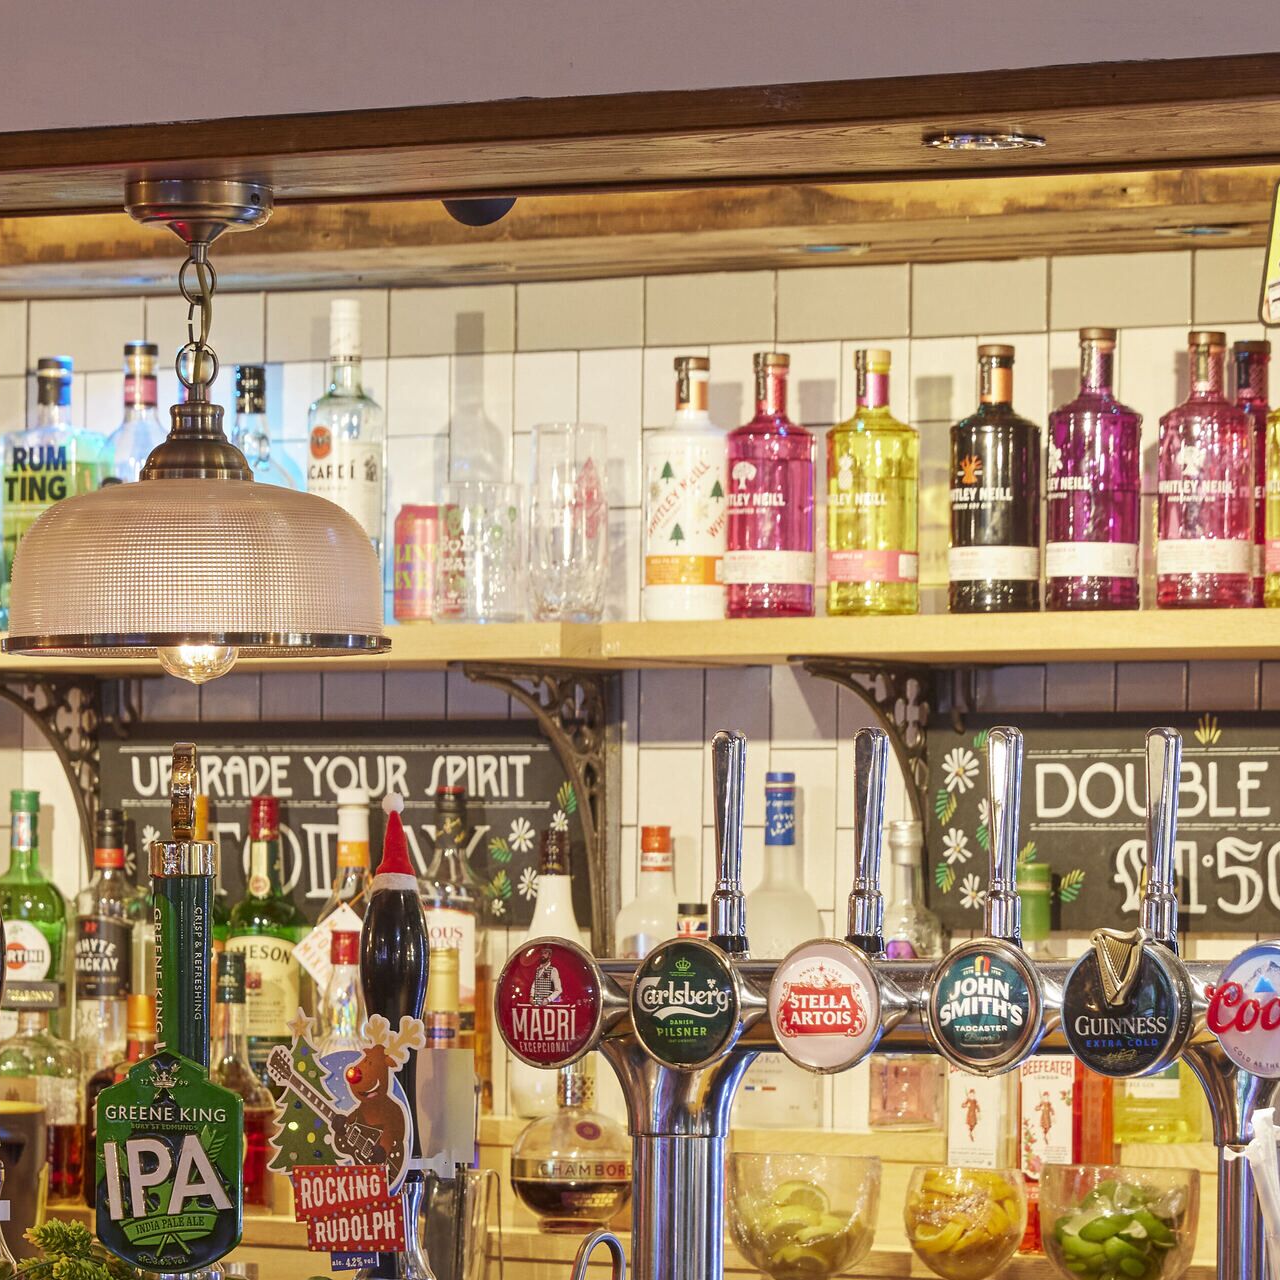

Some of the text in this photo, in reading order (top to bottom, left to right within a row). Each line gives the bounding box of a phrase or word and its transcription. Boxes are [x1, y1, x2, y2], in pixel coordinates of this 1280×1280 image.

[12, 446, 67, 472] RUM
[5, 475, 67, 502] TING
[979, 487, 1013, 501] NEILL
[1061, 477, 1092, 490] NEILL
[1159, 480, 1199, 494] WHITLEY
[131, 754, 532, 798] UPRADE YOUR SPIRIT
[1034, 761, 1271, 819] DOUBLE
[153, 908, 163, 1033] GREENE KING
[194, 906, 203, 1021] CRISP & REFRESHING
[637, 976, 729, 1013] Carlsberg
[949, 977, 1011, 1001] JOHN
[789, 993, 851, 1009] STELLA
[939, 996, 1023, 1027] SMITH'S
[511, 1004, 577, 1041] MADRÍ
[790, 1011, 852, 1025] ARTOIS
[1074, 1015, 1167, 1035] GUINNESS
[657, 1026, 707, 1037] PILSNER
[519, 1040, 571, 1053] EXCEPCIONAL
[1086, 1038, 1158, 1047] EXTRA COLD
[1233, 1046, 1251, 1062] COLD
[1253, 1060, 1263, 1068] AS
[1022, 1060, 1073, 1076] BEEFEATER
[105, 1105, 226, 1122] GREENE KING
[130, 1122, 150, 1130] BURY
[103, 1134, 233, 1221] IPA
[300, 1174, 381, 1210] ROCKING
[135, 1216, 205, 1235] INDIA PALE ALE
[315, 1209, 397, 1244] RUDOLPH
[345, 1256, 363, 1268] 4.2%
[364, 1257, 376, 1265] vol.
